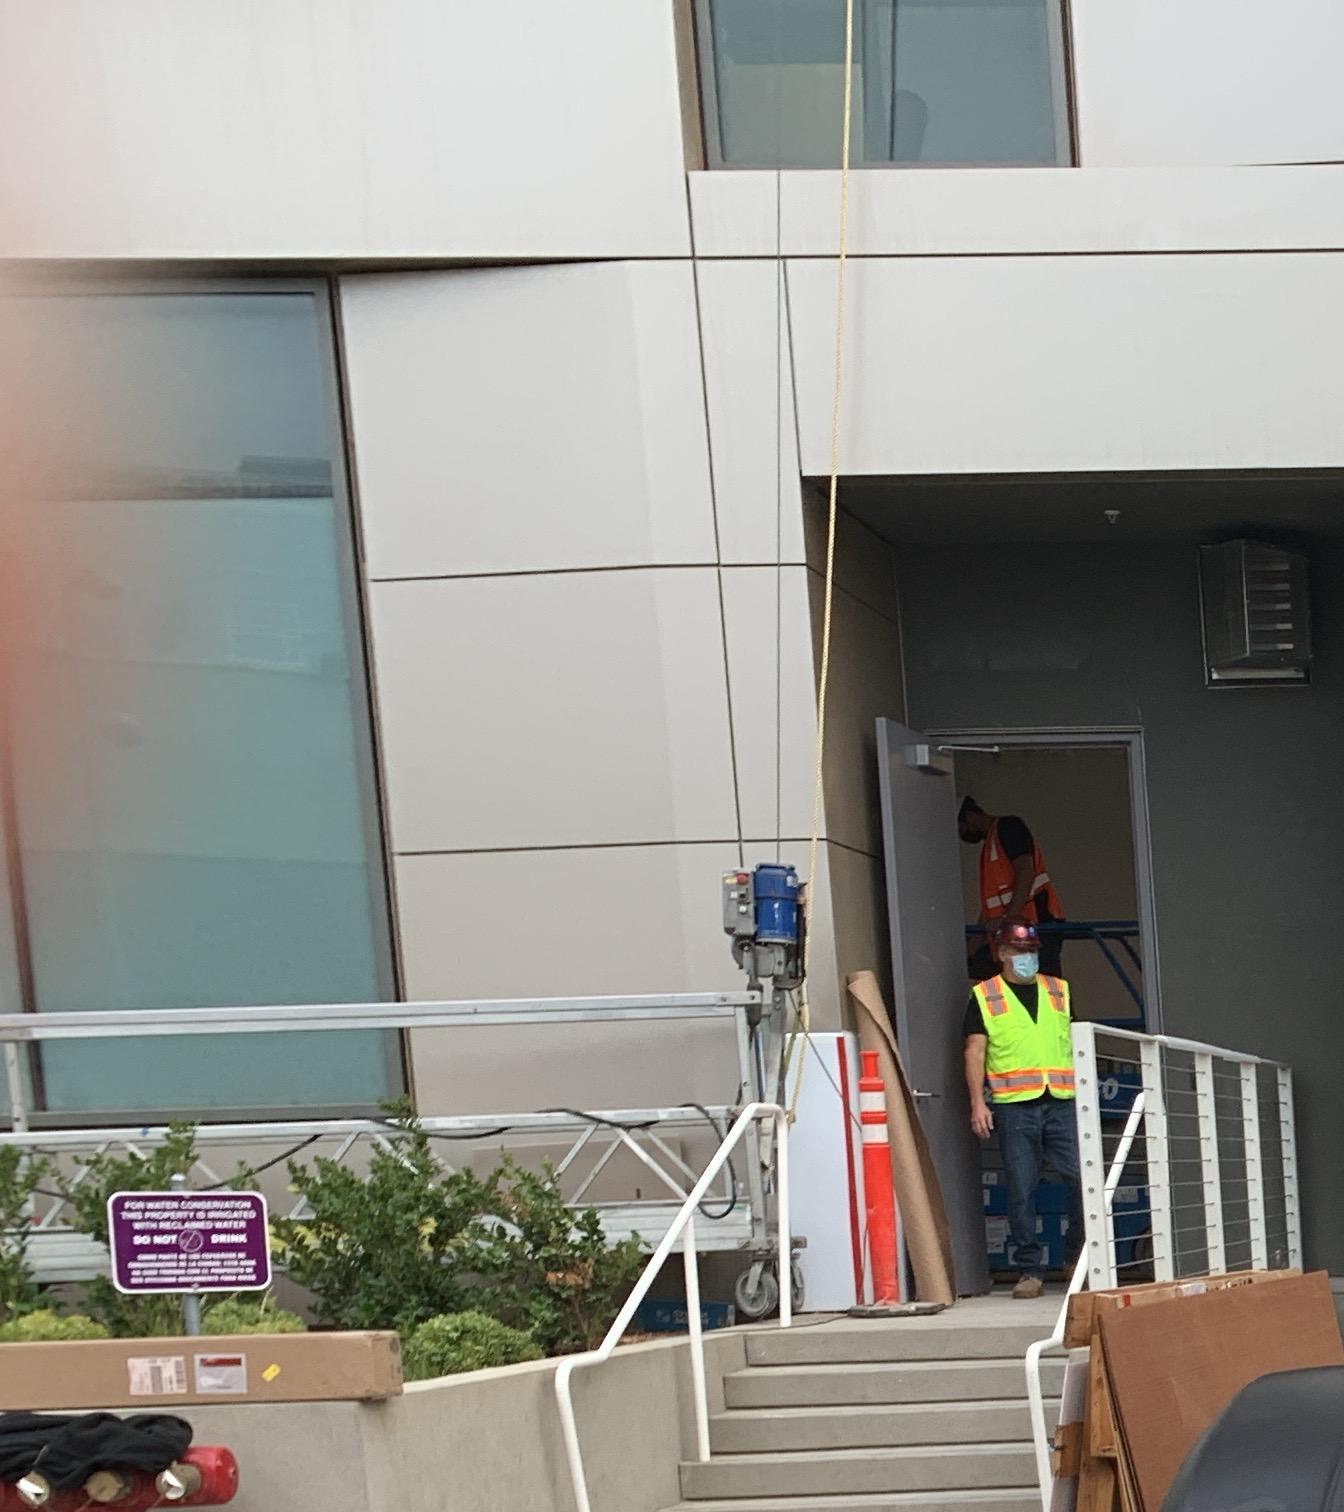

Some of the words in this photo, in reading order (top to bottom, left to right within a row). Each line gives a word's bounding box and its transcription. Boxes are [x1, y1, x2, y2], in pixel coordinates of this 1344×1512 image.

[132, 1235, 151, 1245] DO
[152, 1234, 178, 1245] NOT
[210, 1233, 248, 1244] DRINK
